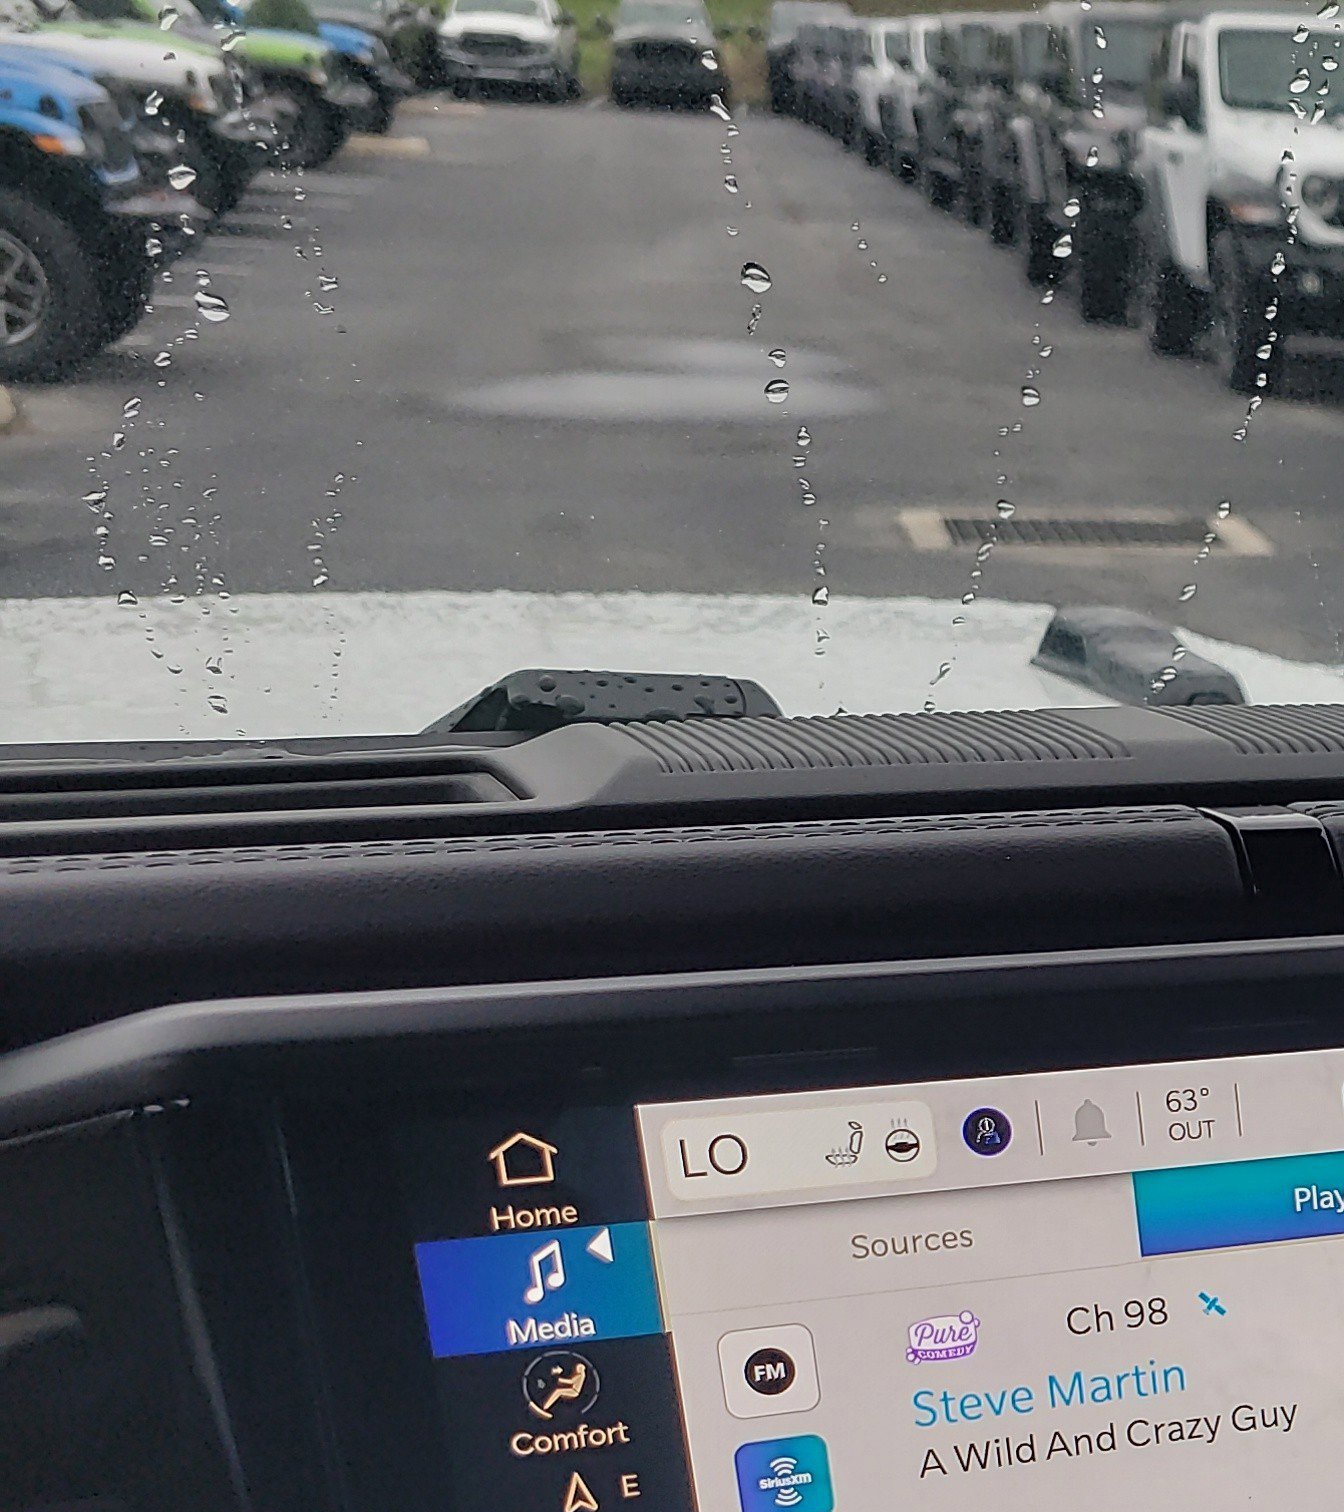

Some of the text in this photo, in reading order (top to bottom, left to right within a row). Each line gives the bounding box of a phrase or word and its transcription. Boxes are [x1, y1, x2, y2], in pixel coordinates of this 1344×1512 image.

[1165, 1086, 1211, 1114] 63°
[1168, 1118, 1216, 1142] OUT
[679, 1132, 750, 1180] LO
[490, 1201, 579, 1231] Home
[850, 1226, 975, 1261] Sources
[507, 1312, 596, 1345] Media
[1066, 1297, 1169, 1336] Ch 98
[914, 1322, 973, 1347] Pure
[918, 1344, 974, 1360] COMEDY
[753, 1362, 786, 1382] FM
[913, 1360, 1187, 1429] Steve Martin
[511, 1420, 631, 1458] Comfort
[919, 1403, 1298, 1480] A Wild And Crazy Guy
[621, 1474, 641, 1498] E
